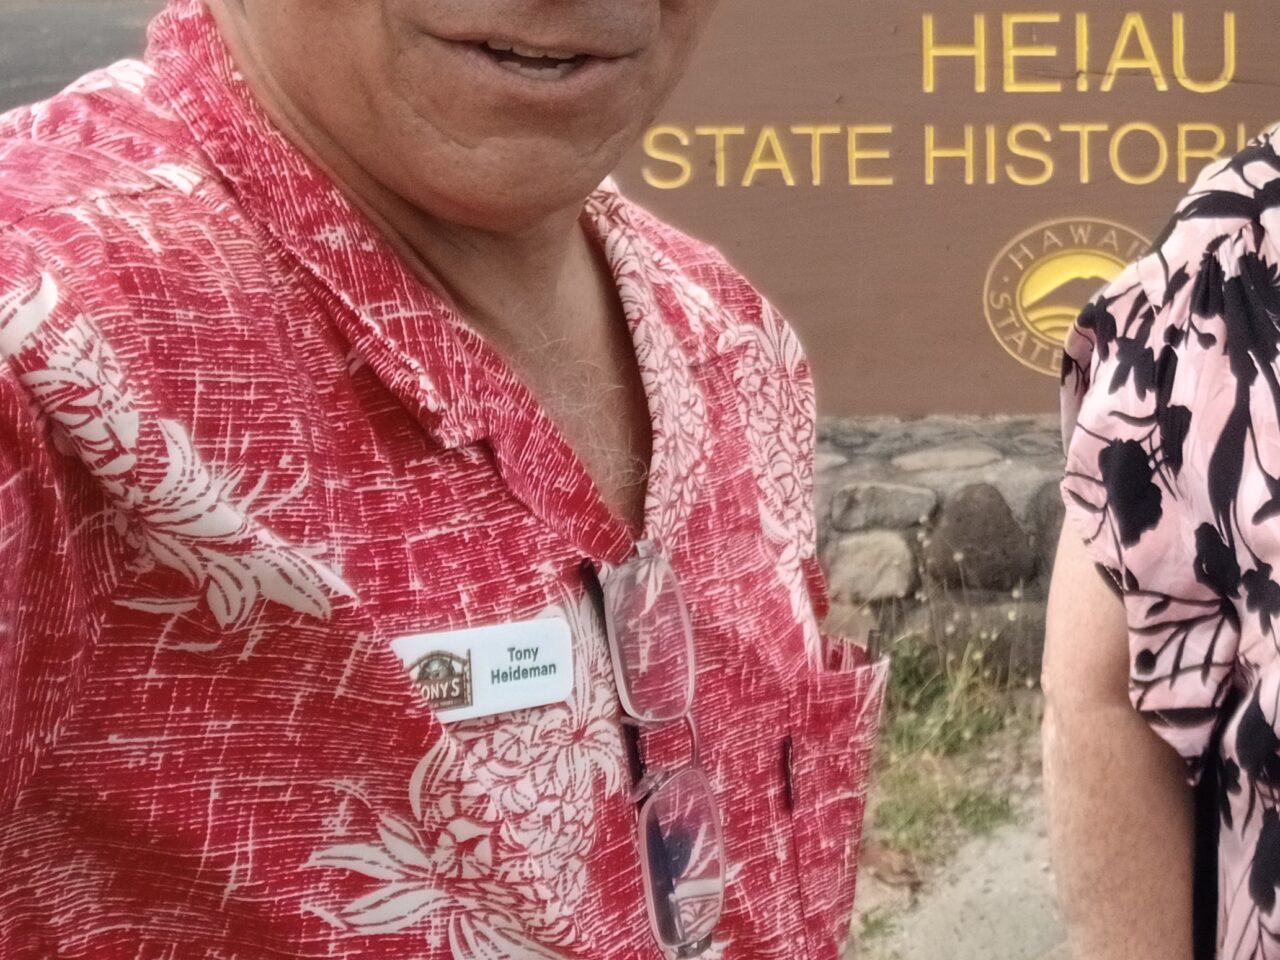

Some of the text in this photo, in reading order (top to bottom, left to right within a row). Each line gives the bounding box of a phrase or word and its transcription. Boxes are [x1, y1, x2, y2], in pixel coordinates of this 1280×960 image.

[922, 11, 1236, 94] HEIAU
[641, 125, 894, 189] STATE
[490, 663, 557, 685] Heideman
[507, 646, 540, 662] Tony
